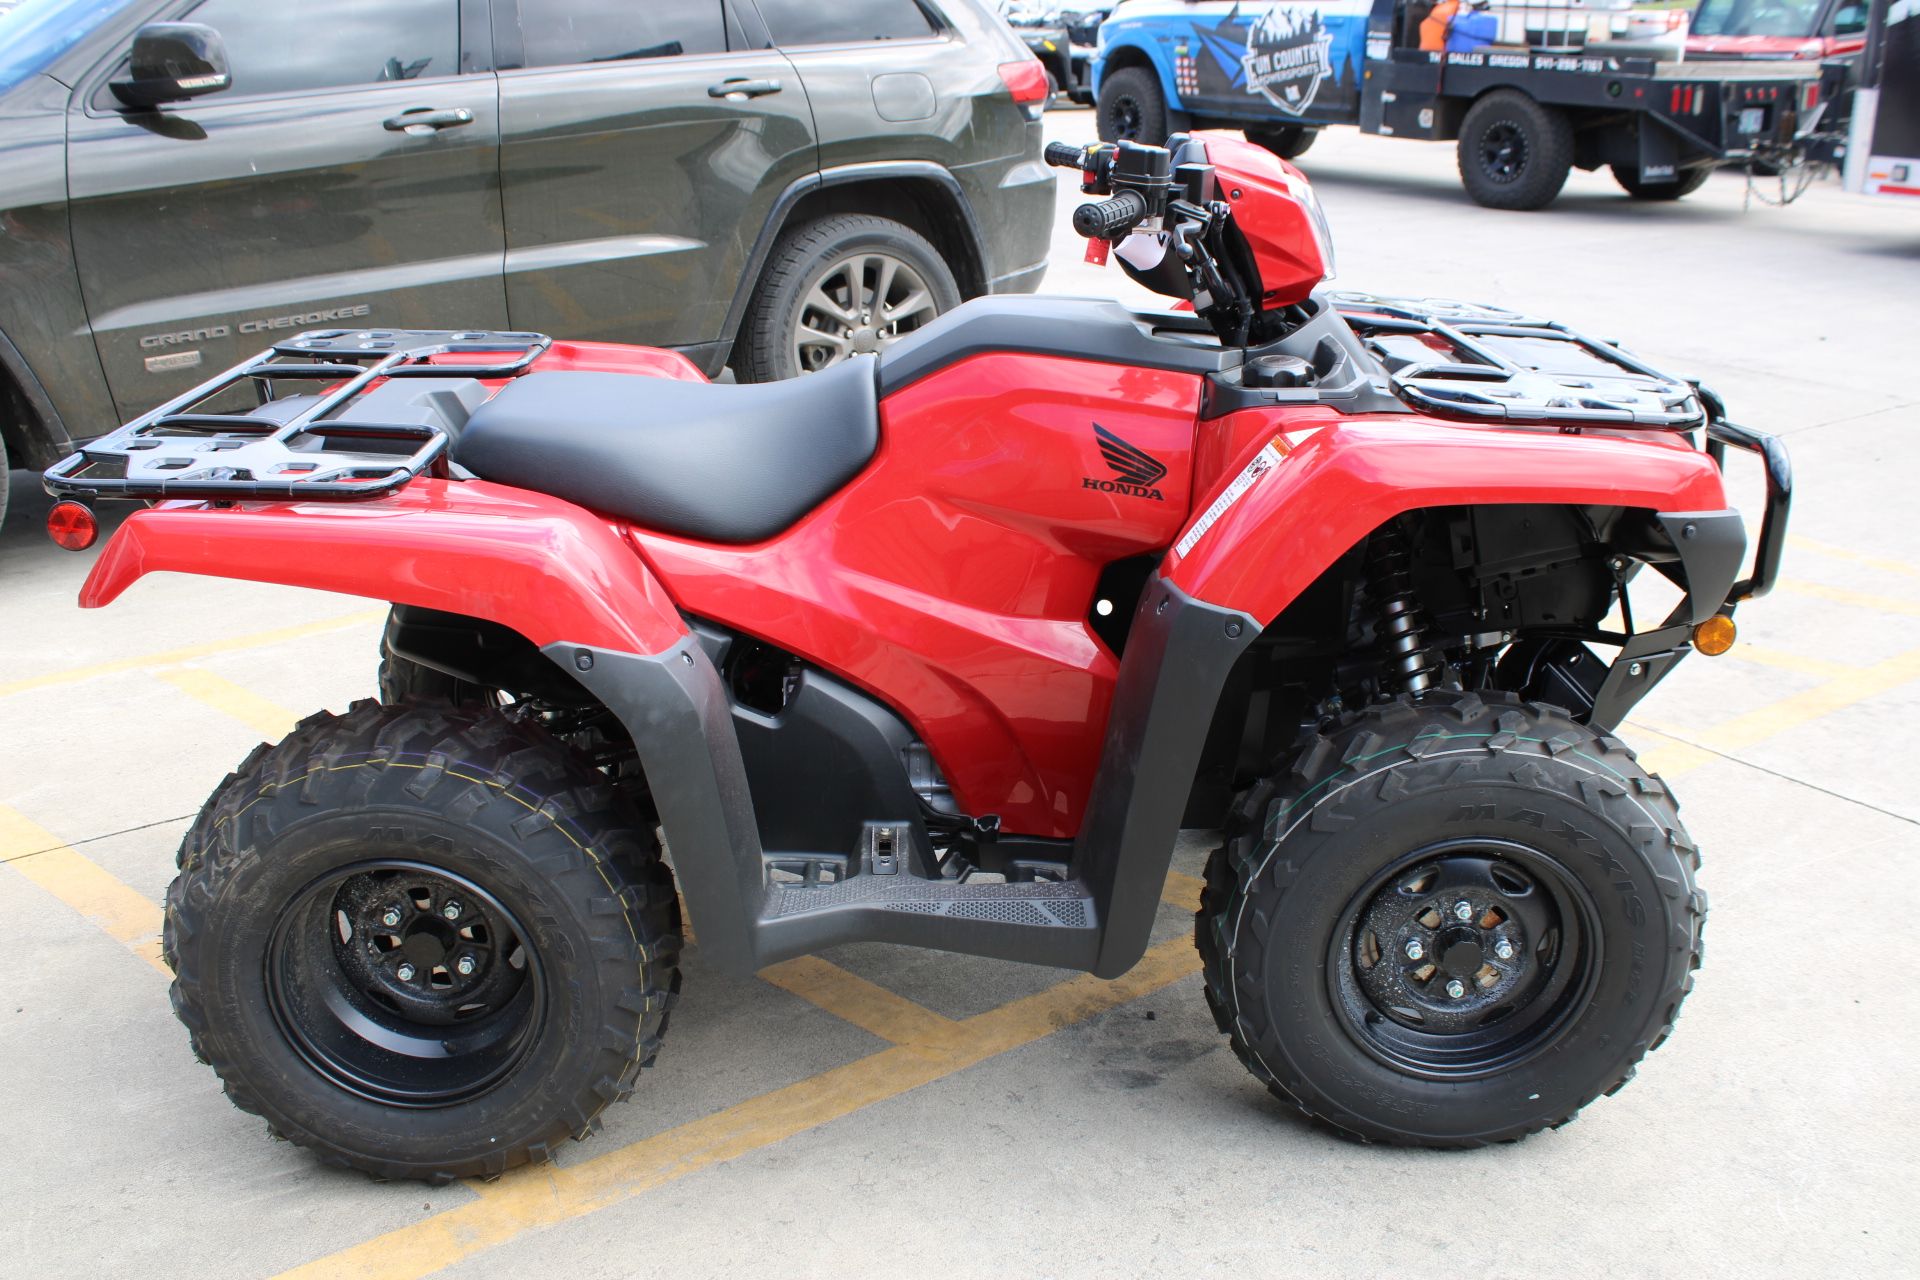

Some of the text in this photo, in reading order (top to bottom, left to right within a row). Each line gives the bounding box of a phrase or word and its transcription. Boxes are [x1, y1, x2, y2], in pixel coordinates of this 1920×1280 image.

[1273, 41, 1327, 72] COUNTRY
[1447, 52, 1484, 66] DALLES
[1488, 54, 1530, 68] OREGON
[139, 303, 370, 348] GRAND CHEROKEE
[1081, 477, 1165, 501] HONDA
[1446, 802, 1647, 928] MAXXIS
[361, 825, 576, 962] MAXXIS
